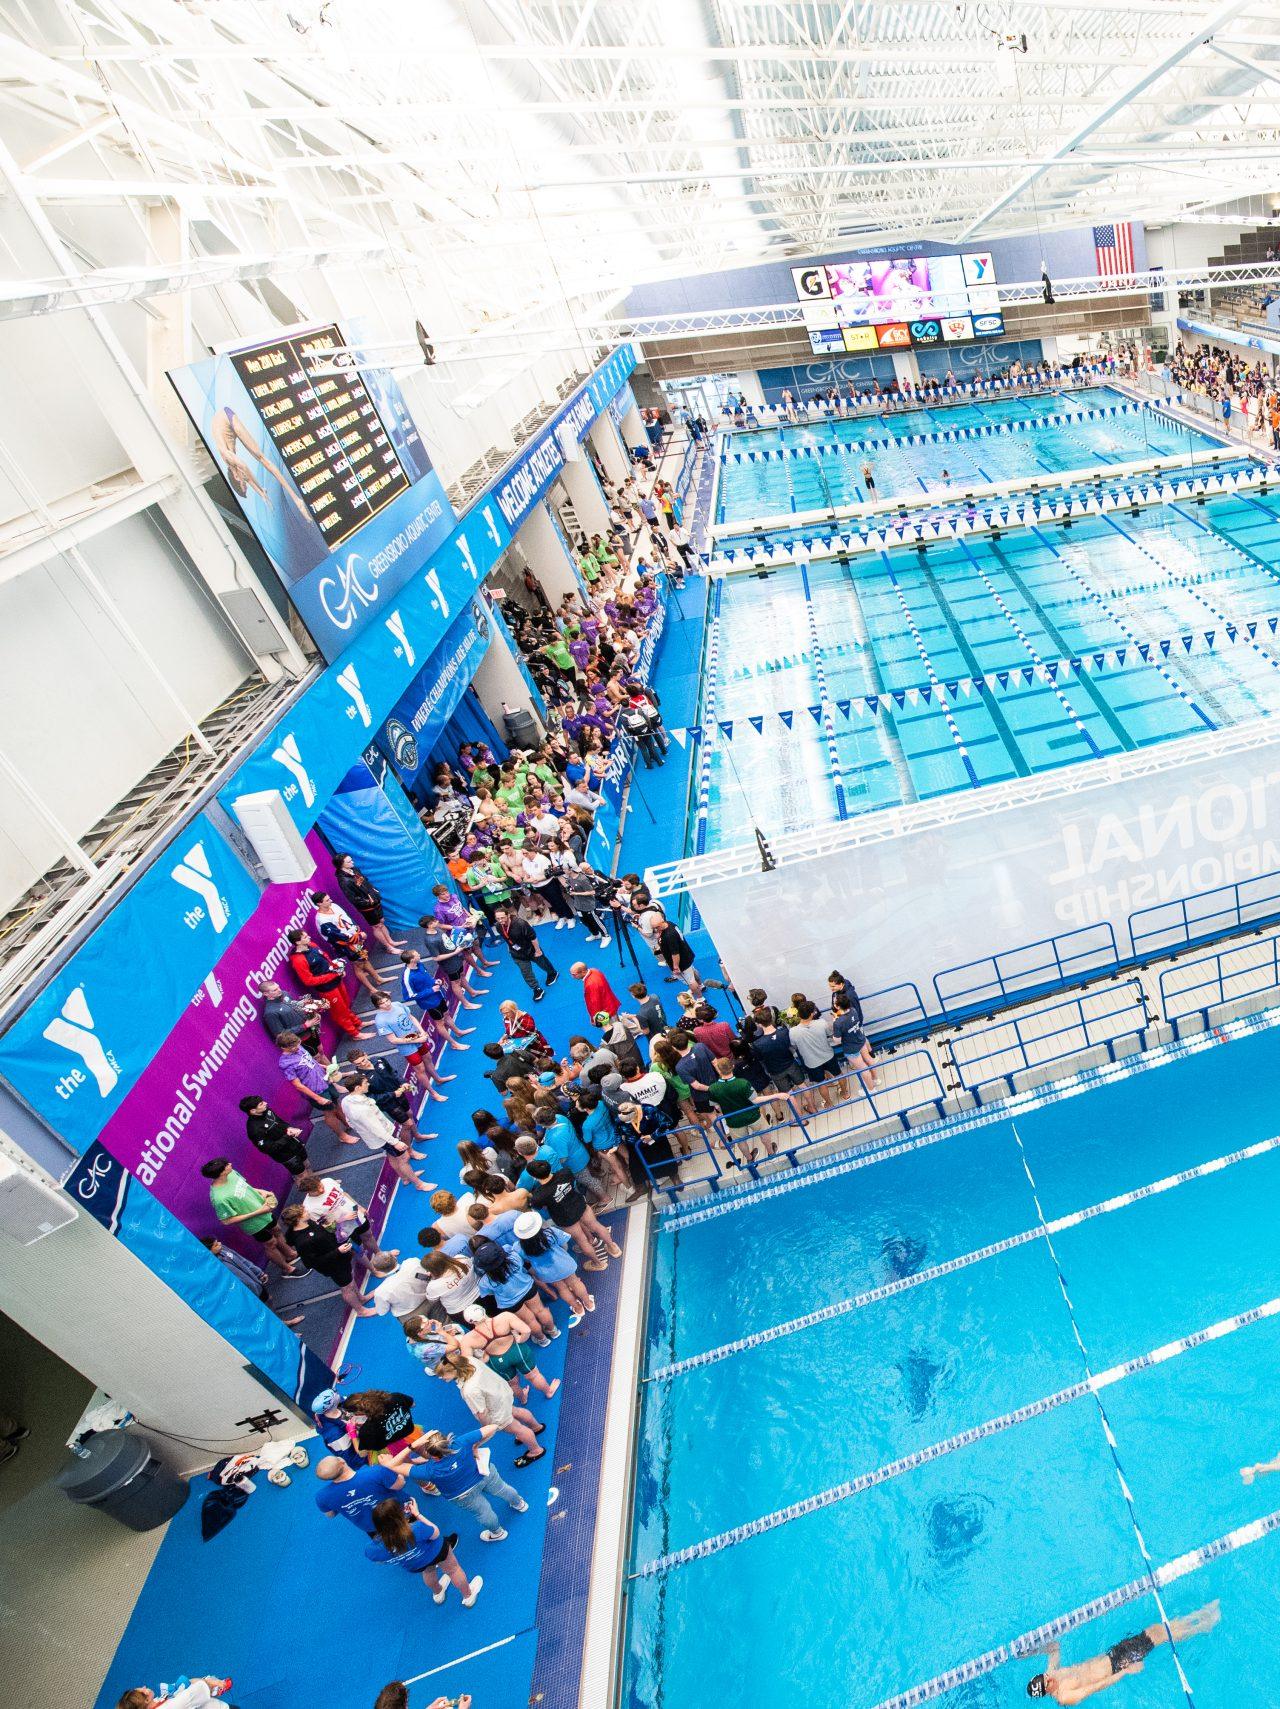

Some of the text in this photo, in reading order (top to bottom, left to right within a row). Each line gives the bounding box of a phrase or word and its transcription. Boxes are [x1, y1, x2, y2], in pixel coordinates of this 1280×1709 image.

[497, 435, 565, 525] WELCOME ATHLETES
[368, 499, 443, 579] GREENSBORO AQUATIC CENTER
[411, 628, 478, 733] WHERE CHAMPIONS ARE MADE
[345, 702, 360, 720] the
[283, 782, 299, 802] the
[183, 905, 205, 931] the
[179, 990, 255, 1101] Swimming
[55, 1066, 86, 1100] the
[377, 1184, 388, 1204] 6th
